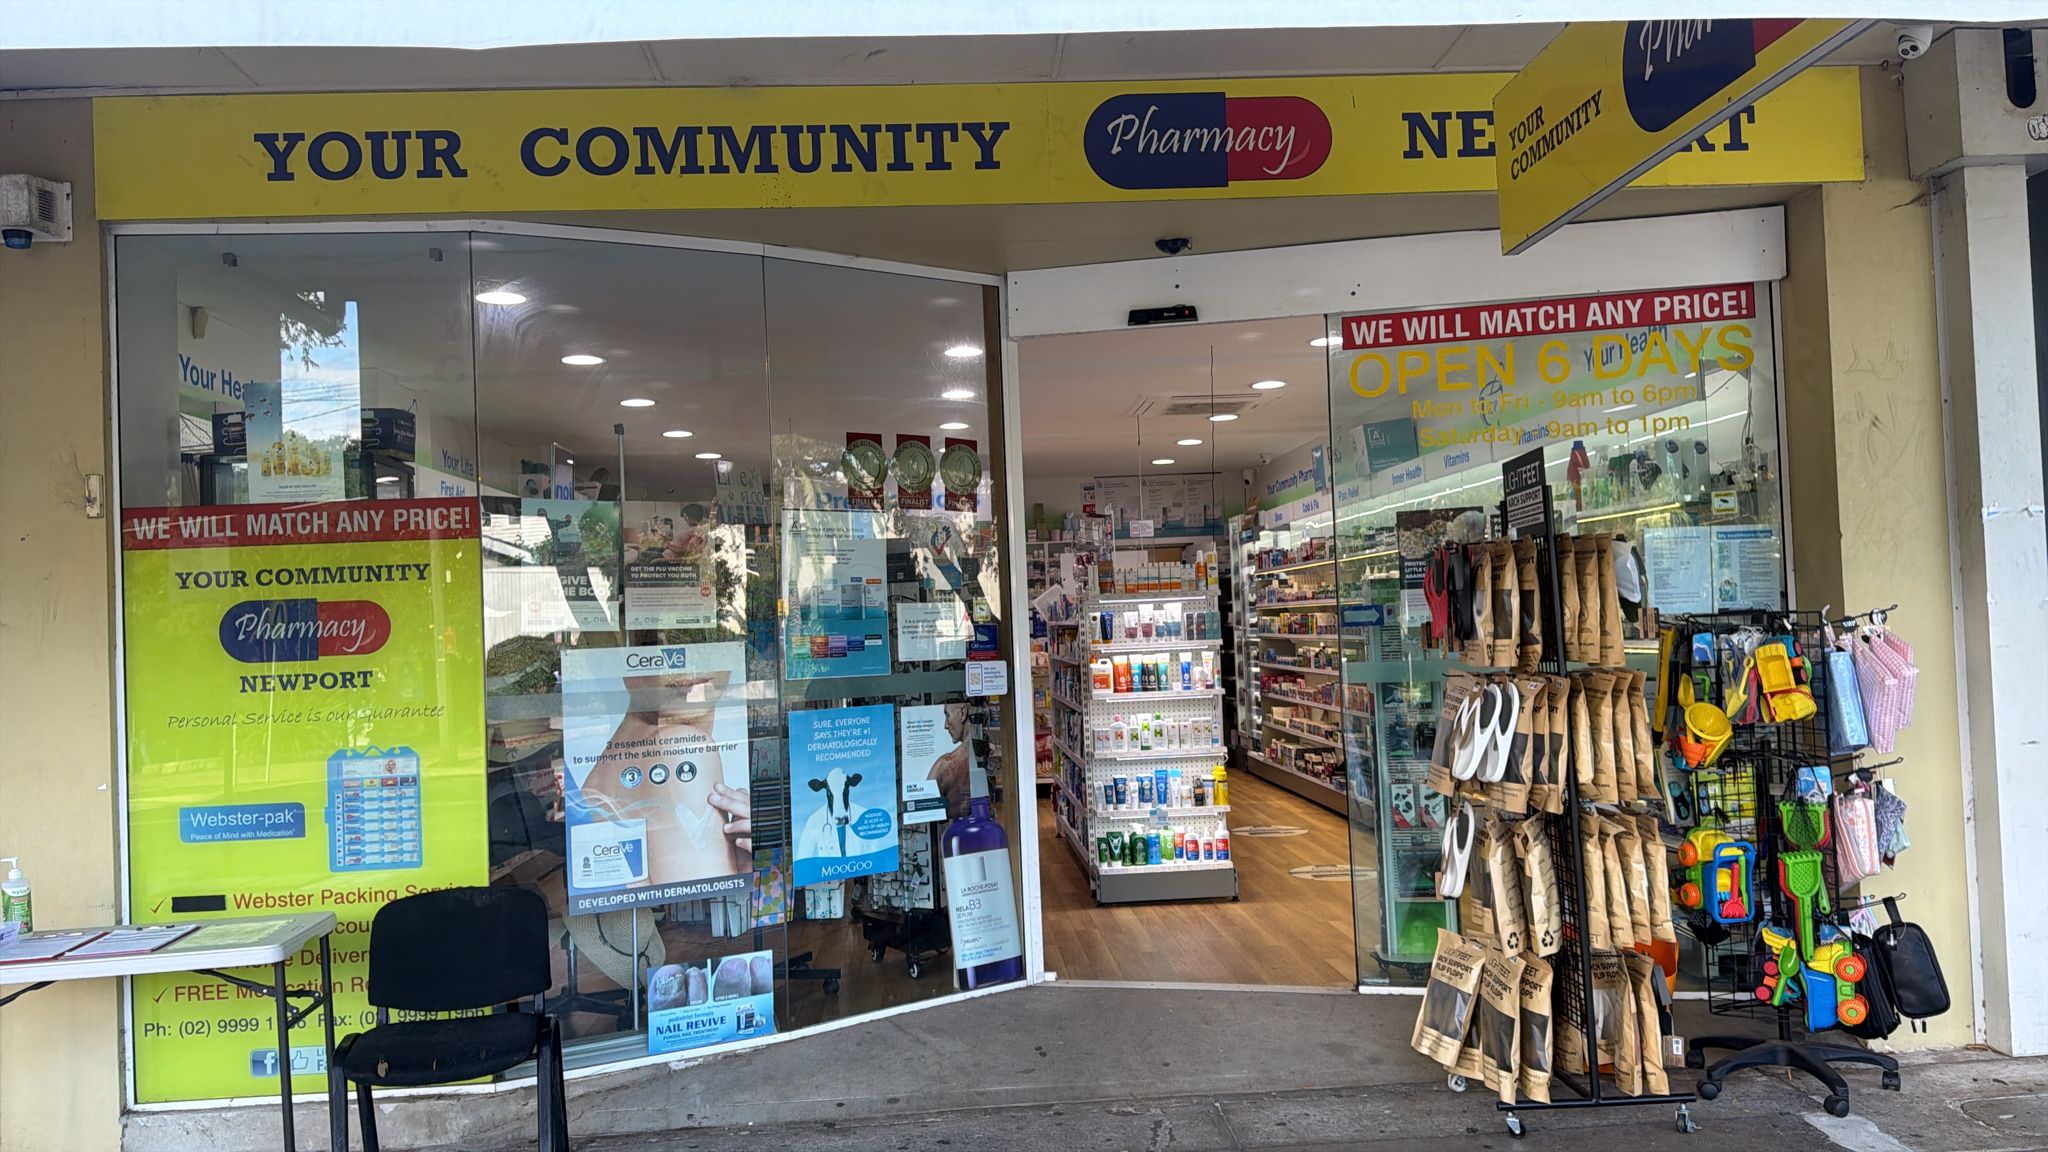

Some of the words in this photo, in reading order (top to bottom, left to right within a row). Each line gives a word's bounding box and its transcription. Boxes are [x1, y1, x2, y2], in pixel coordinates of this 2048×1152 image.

[1508, 105, 1545, 151] YOUR
[1510, 88, 1602, 181] COMMUNITY
[1107, 104, 1297, 175] Pharmacy
[253, 129, 468, 182] YOUR
[519, 121, 1010, 178] COMMUNITY
[1350, 319, 1393, 346] WE
[1402, 313, 1470, 341] WILL
[1480, 304, 1577, 335] MATCH
[1585, 298, 1644, 327] ANY
[1654, 289, 1748, 322] PRICE!
[1349, 341, 1516, 398] OPEN
[1537, 340, 1570, 385] 6
[1592, 323, 1756, 380] DAYS
[179, 353, 217, 391] Your
[1412, 398, 1463, 419] Mon
[1470, 397, 1493, 417] to
[1500, 393, 1529, 413] Fri
[1552, 388, 1604, 410] 9am
[1612, 386, 1635, 405] to
[1643, 382, 1696, 410] 6pm
[1420, 424, 1523, 448] Saturday
[1548, 415, 1598, 439] 9am
[1607, 413, 1630, 436] to
[1638, 413, 1690, 438] 1pm
[1443, 449, 1470, 469] Vitamins
[1391, 470, 1405, 486] Inner
[1405, 465, 1423, 482] Health
[1504, 461, 1540, 492] LIGHTFEET
[440, 480, 455, 497] First
[1520, 488, 1541, 505] SUPPORT
[132, 516, 171, 541] WE
[179, 514, 239, 540] WILL
[246, 512, 328, 538] MATCH
[336, 508, 386, 535] ANY
[393, 505, 472, 533] PRICE!
[175, 570, 249, 590] YOUR
[255, 562, 431, 588] COMMUNITY
[560, 575, 588, 585] GIVE
[234, 607, 367, 653] Pharmacy
[626, 650, 685, 668] CeraVe
[240, 670, 374, 693] NEWPORT
[168, 711, 238, 729] Personal
[241, 711, 302, 726] Service
[307, 709, 321, 723] is
[326, 710, 352, 722] our
[358, 704, 445, 722] guarantee
[835, 716, 871, 727] EVERYONE
[606, 741, 613, 750] 3
[615, 739, 657, 749] essential
[658, 734, 707, 746] ceramides
[807, 737, 878, 751] DERMATOLOGICALLY
[814, 731, 832, 740] SAYS
[833, 728, 862, 738] THEY'RE
[863, 727, 871, 736] #1
[573, 756, 583, 764] to
[585, 752, 623, 765] support
[625, 750, 640, 759] the
[642, 749, 661, 758] skin
[663, 745, 704, 757] moisture
[705, 743, 738, 753] barrier
[815, 749, 871, 762] RECOMMENDED
[628, 771, 636, 782] 3
[190, 808, 296, 828] Webster-pak
[190, 833, 213, 841] Peace
[214, 832, 221, 840] of
[222, 831, 240, 839] Mind
[593, 841, 633, 857] CeraVe
[821, 860, 873, 878] MooGoo
[233, 892, 314, 910] Webster
[320, 887, 398, 906] Packing
[579, 893, 636, 909] DEVELOPED
[637, 889, 663, 902] WITH
[664, 878, 745, 898] DERMATOLOGISTS
[1435, 962, 1446, 972] FLIP
[1446, 966, 1465, 980] FLOPS
[1446, 957, 1474, 975] SUPPORT
[1594, 970, 1606, 980] FLIP
[174, 984, 229, 1002] FREE
[144, 1022, 172, 1037] Ph:
[178, 1020, 211, 1039] (02)
[217, 1017, 260, 1034] 9999
[397, 1007, 439, 1022] 9999
[655, 1023, 683, 1036] NAIL
[686, 1015, 727, 1030] REVIVE
